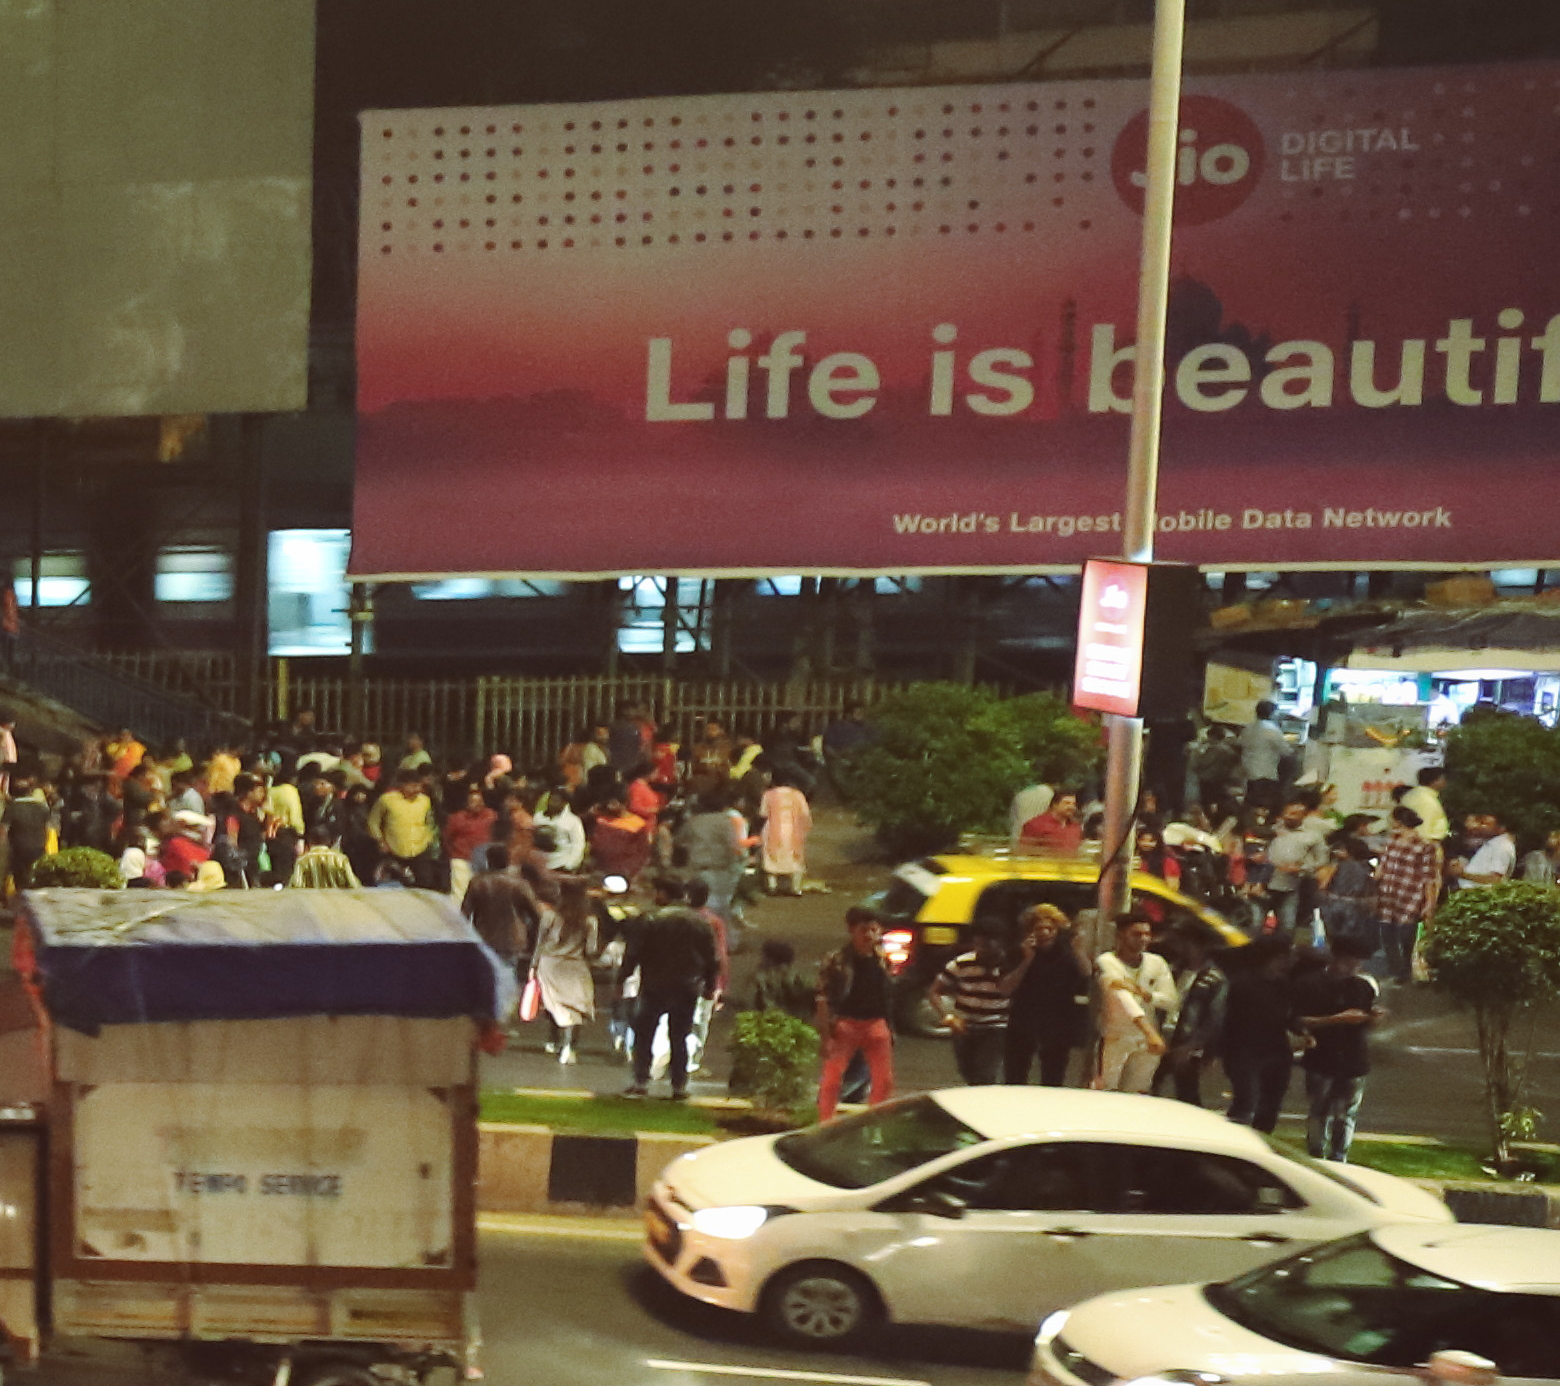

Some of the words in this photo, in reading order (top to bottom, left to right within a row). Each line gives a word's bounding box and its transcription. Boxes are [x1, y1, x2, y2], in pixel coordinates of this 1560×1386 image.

[1280, 126, 1420, 156] DIGITAL
[1280, 156, 1357, 183] LIFE
[645, 327, 882, 423] Life
[929, 321, 1036, 417] is
[893, 511, 1001, 535] World's
[1010, 510, 1122, 538] Largest
[1153, 509, 1233, 532] obile
[1242, 508, 1313, 531] Data
[1322, 506, 1454, 530] Network
